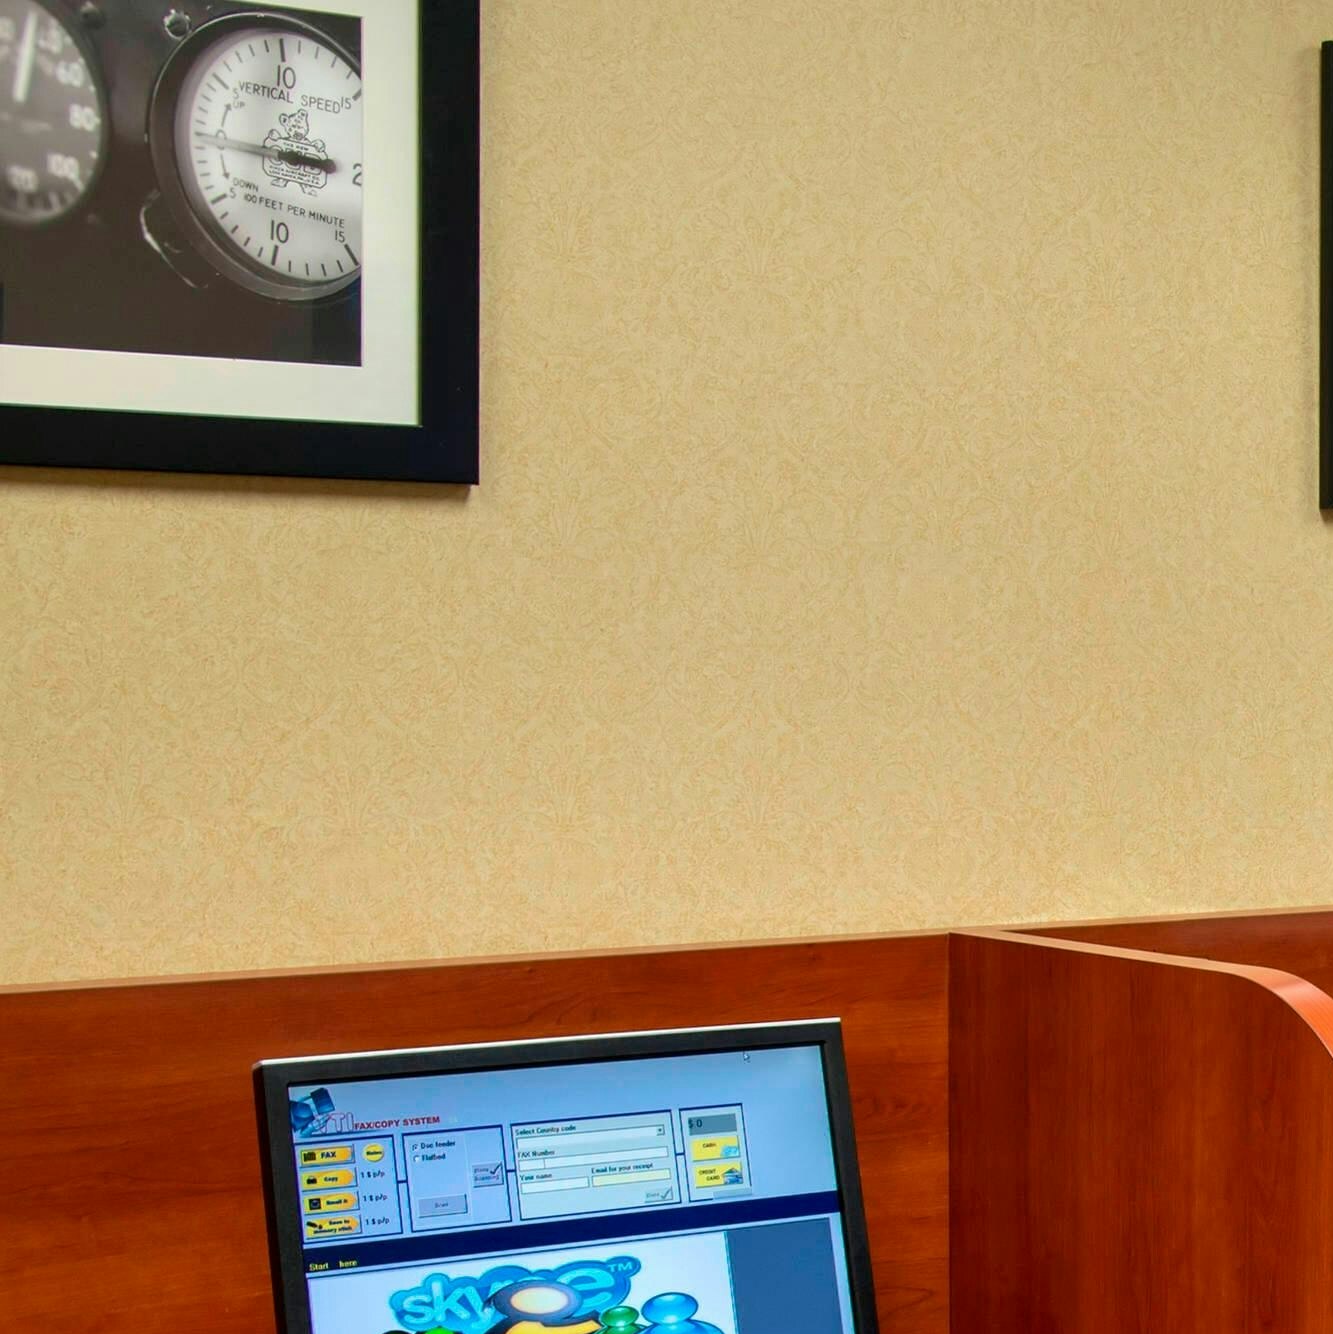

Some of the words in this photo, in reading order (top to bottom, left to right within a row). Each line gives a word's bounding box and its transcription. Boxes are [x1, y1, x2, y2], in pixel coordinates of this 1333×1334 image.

[277, 65, 296, 89] 10
[238, 81, 294, 104] VERTICAL
[301, 94, 341, 114] SPEED
[340, 96, 352, 110] 15
[233, 177, 259, 192] DOWN
[259, 197, 283, 211] FEET
[288, 204, 306, 217] PER
[308, 211, 345, 229] MINUTE
[270, 220, 289, 244] 10
[335, 230, 345, 243] 15
[354, 1119, 400, 1130] FAX/COPY
[402, 1116, 440, 1126] SYSTEM
[321, 1151, 337, 1159] FAX
[309, 1262, 329, 1271] Start
[338, 1259, 358, 1268] here
[403, 1268, 616, 1332] skye
